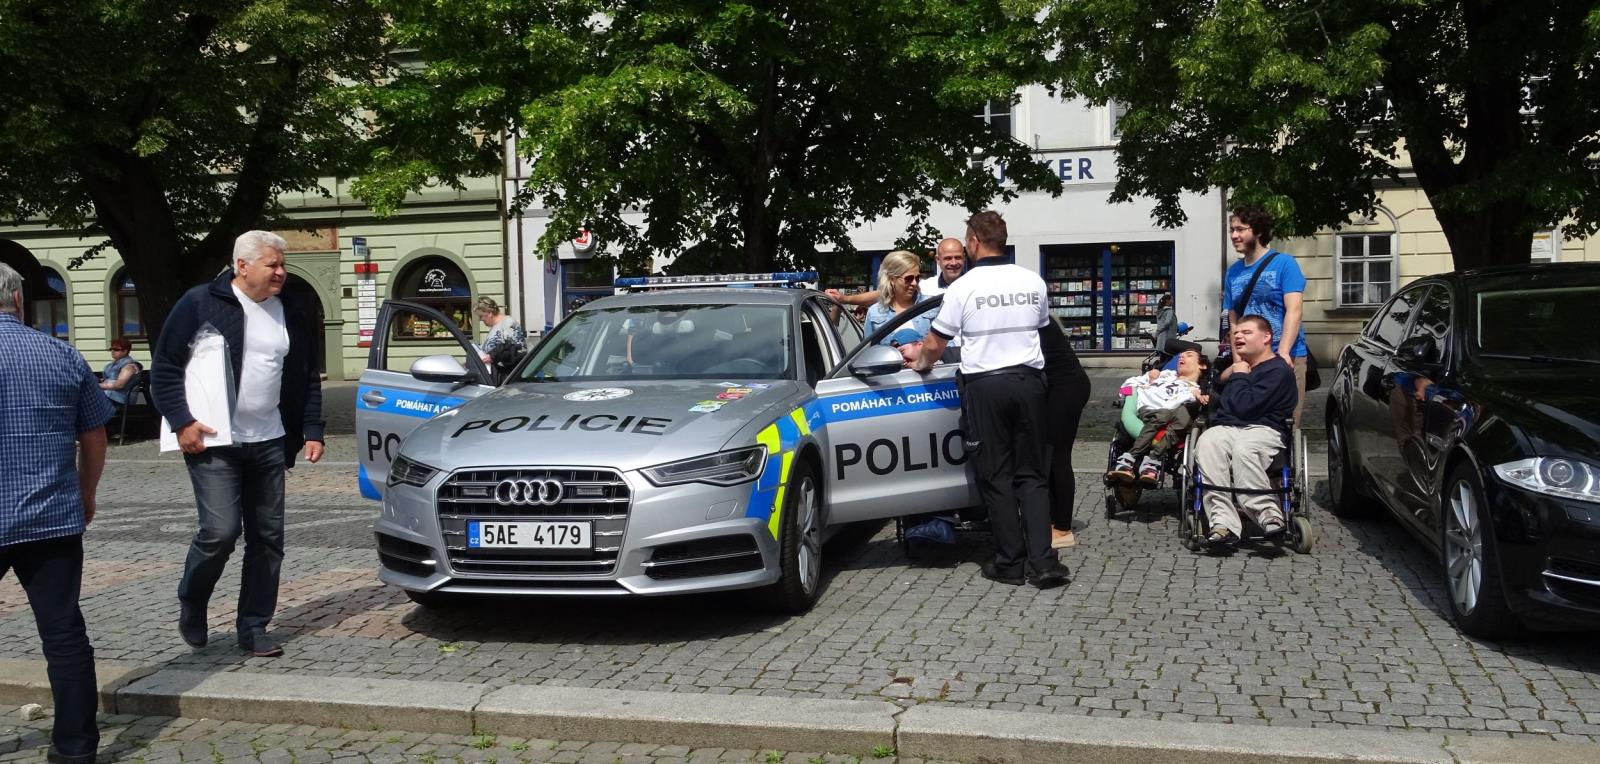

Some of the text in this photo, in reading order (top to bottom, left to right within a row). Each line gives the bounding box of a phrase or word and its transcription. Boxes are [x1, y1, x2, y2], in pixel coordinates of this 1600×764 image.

[975, 291, 1039, 310] POLICIE
[396, 399, 432, 413] POMÁHAT
[433, 405, 440, 414] A
[831, 389, 960, 414] POMÁHAT A CHRÁNIT
[450, 414, 673, 438] POLICIE
[484, 525, 581, 545] 5AE 4179
